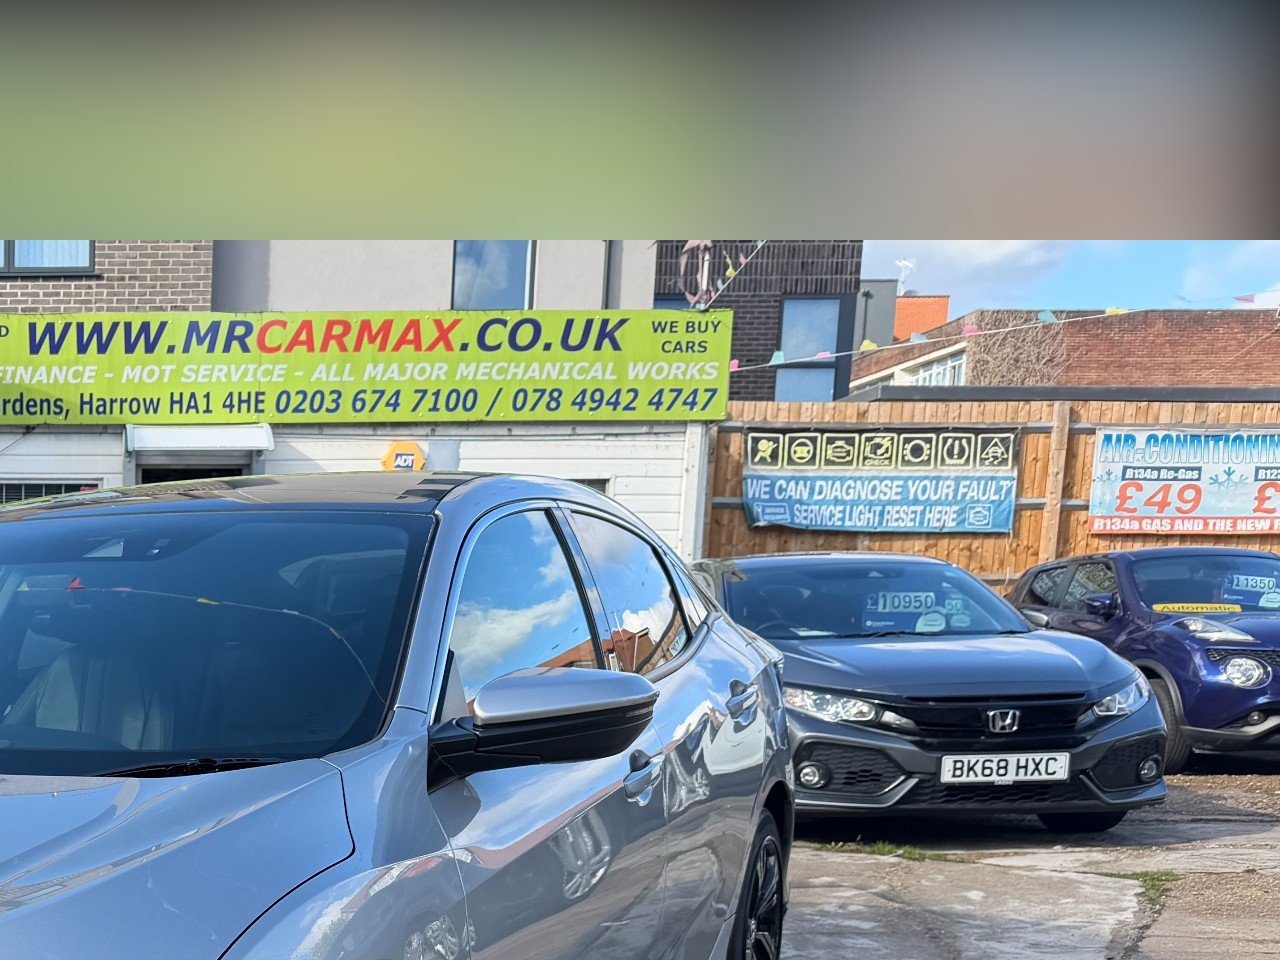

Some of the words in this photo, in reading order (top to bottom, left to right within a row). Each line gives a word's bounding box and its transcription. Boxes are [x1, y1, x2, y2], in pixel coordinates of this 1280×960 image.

[28, 317, 629, 356] WWW.MRCARMAX.CO.UK
[651, 321, 681, 334] WE
[685, 320, 721, 334] BUY
[661, 340, 708, 354] CARS
[122, 364, 176, 384] MOT
[181, 364, 287, 383] SERVICE
[310, 363, 356, 382] ALL
[363, 362, 448, 382] MAJOR
[454, 362, 617, 381] MECHANICAL
[628, 361, 719, 380] WORKS
[79, 391, 162, 416] Harrow
[169, 391, 213, 415] HA1
[222, 390, 266, 414] 4HE
[275, 390, 341, 414] 0203
[351, 389, 400, 413] 674
[410, 388, 478, 413] 7100
[485, 387, 503, 416] /
[511, 388, 563, 412] 078
[571, 387, 639, 412] 4942
[648, 387, 718, 412] 4747
[394, 455, 414, 467] ADT
[1125, 468, 1157, 480] R134a
[1160, 468, 1199, 480] Re-Gas
[747, 479, 770, 499] WE
[774, 479, 810, 500] CAN
[814, 480, 905, 501] DIAGNOSE
[909, 480, 955, 501] YOUR
[957, 479, 1013, 501] FAULT
[1114, 481, 1203, 515] £49
[794, 504, 843, 526] SERVICE
[845, 505, 881, 527] LIGHT
[884, 505, 921, 527] RESET
[924, 505, 958, 527] HERE
[1093, 518, 1139, 531] R134a
[1142, 518, 1171, 531] GAS
[1174, 518, 1204, 531] AND
[1207, 518, 1233, 531] THE
[1237, 518, 1270, 531] NEW
[951, 759, 1008, 778] BK68
[1015, 757, 1057, 777] HXC
